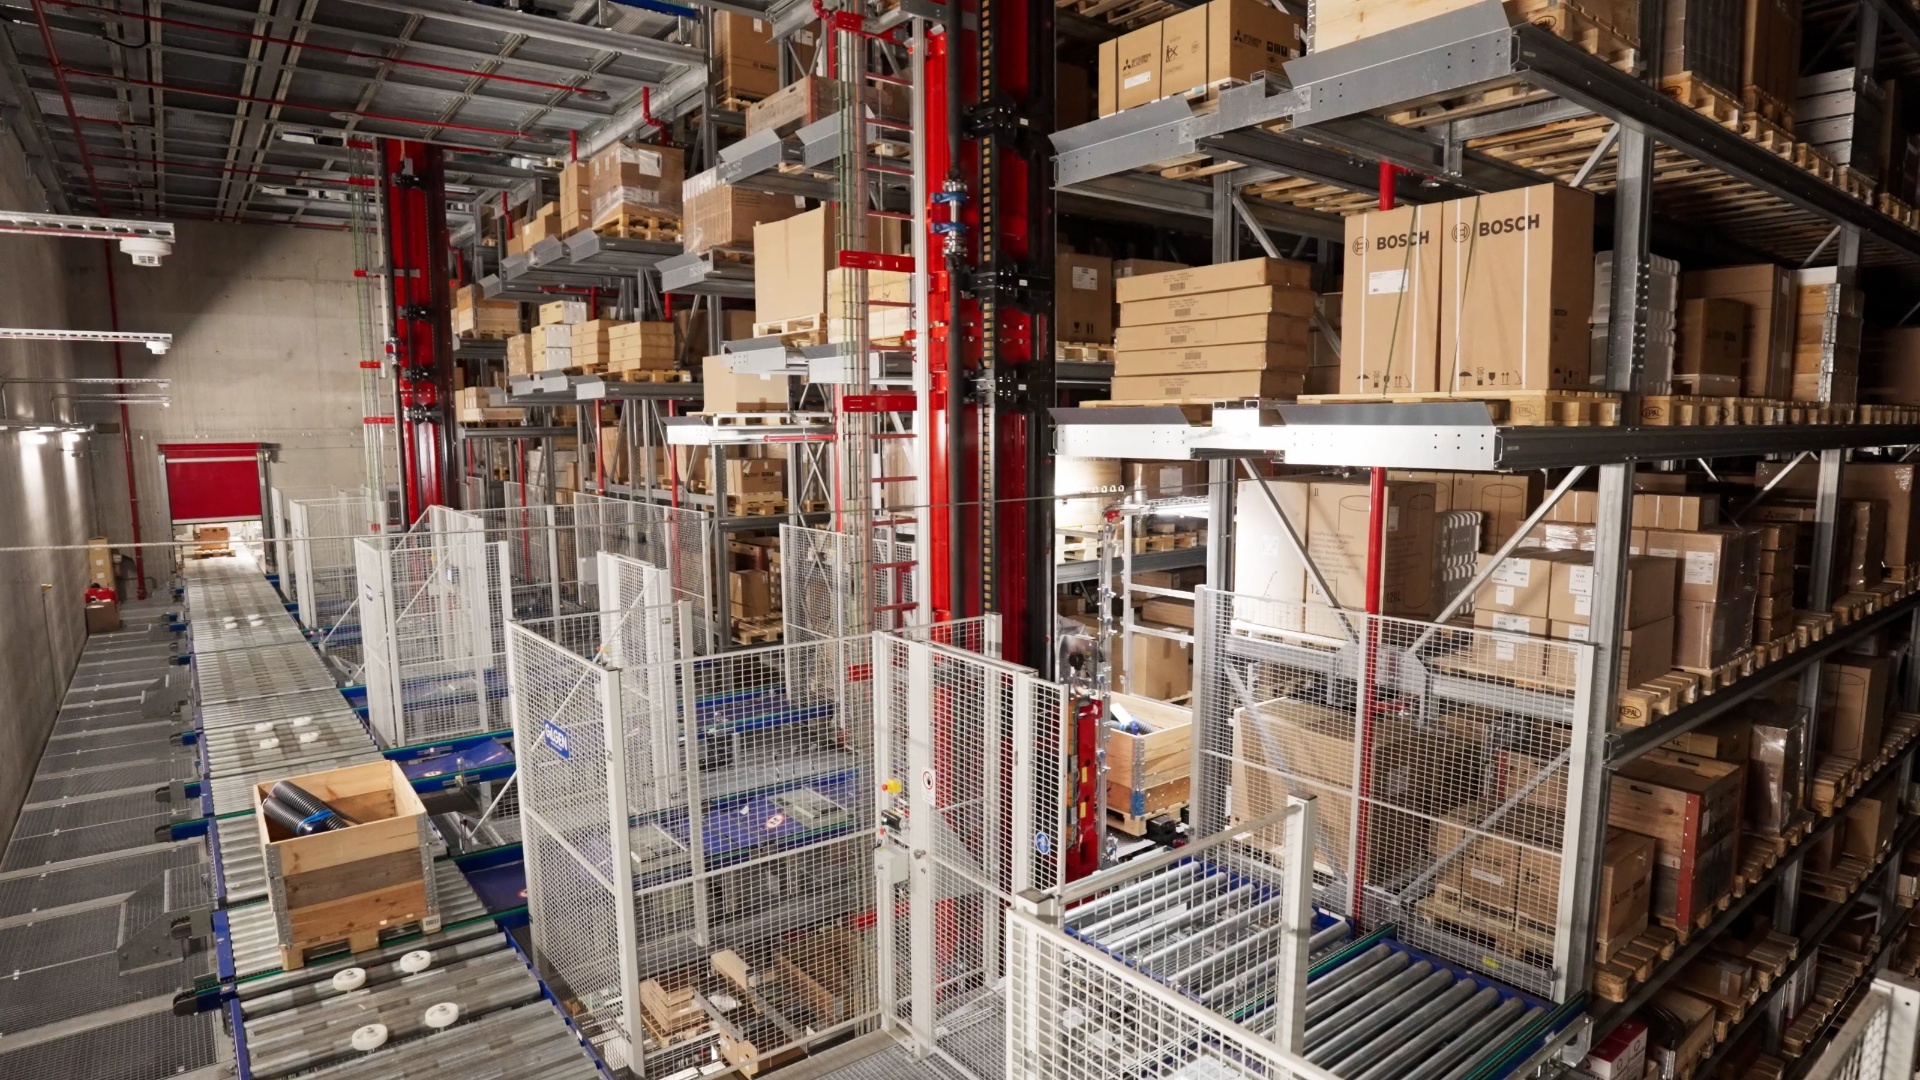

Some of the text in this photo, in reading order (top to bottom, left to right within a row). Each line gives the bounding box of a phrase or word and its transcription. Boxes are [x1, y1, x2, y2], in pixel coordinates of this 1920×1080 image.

[1479, 214, 1540, 237] BOSCH
[1377, 231, 1430, 250] BOSCH
[1645, 409, 1661, 417] EPAL
[1623, 707, 1637, 717] EPAL
[545, 723, 568, 751] GILGEN
